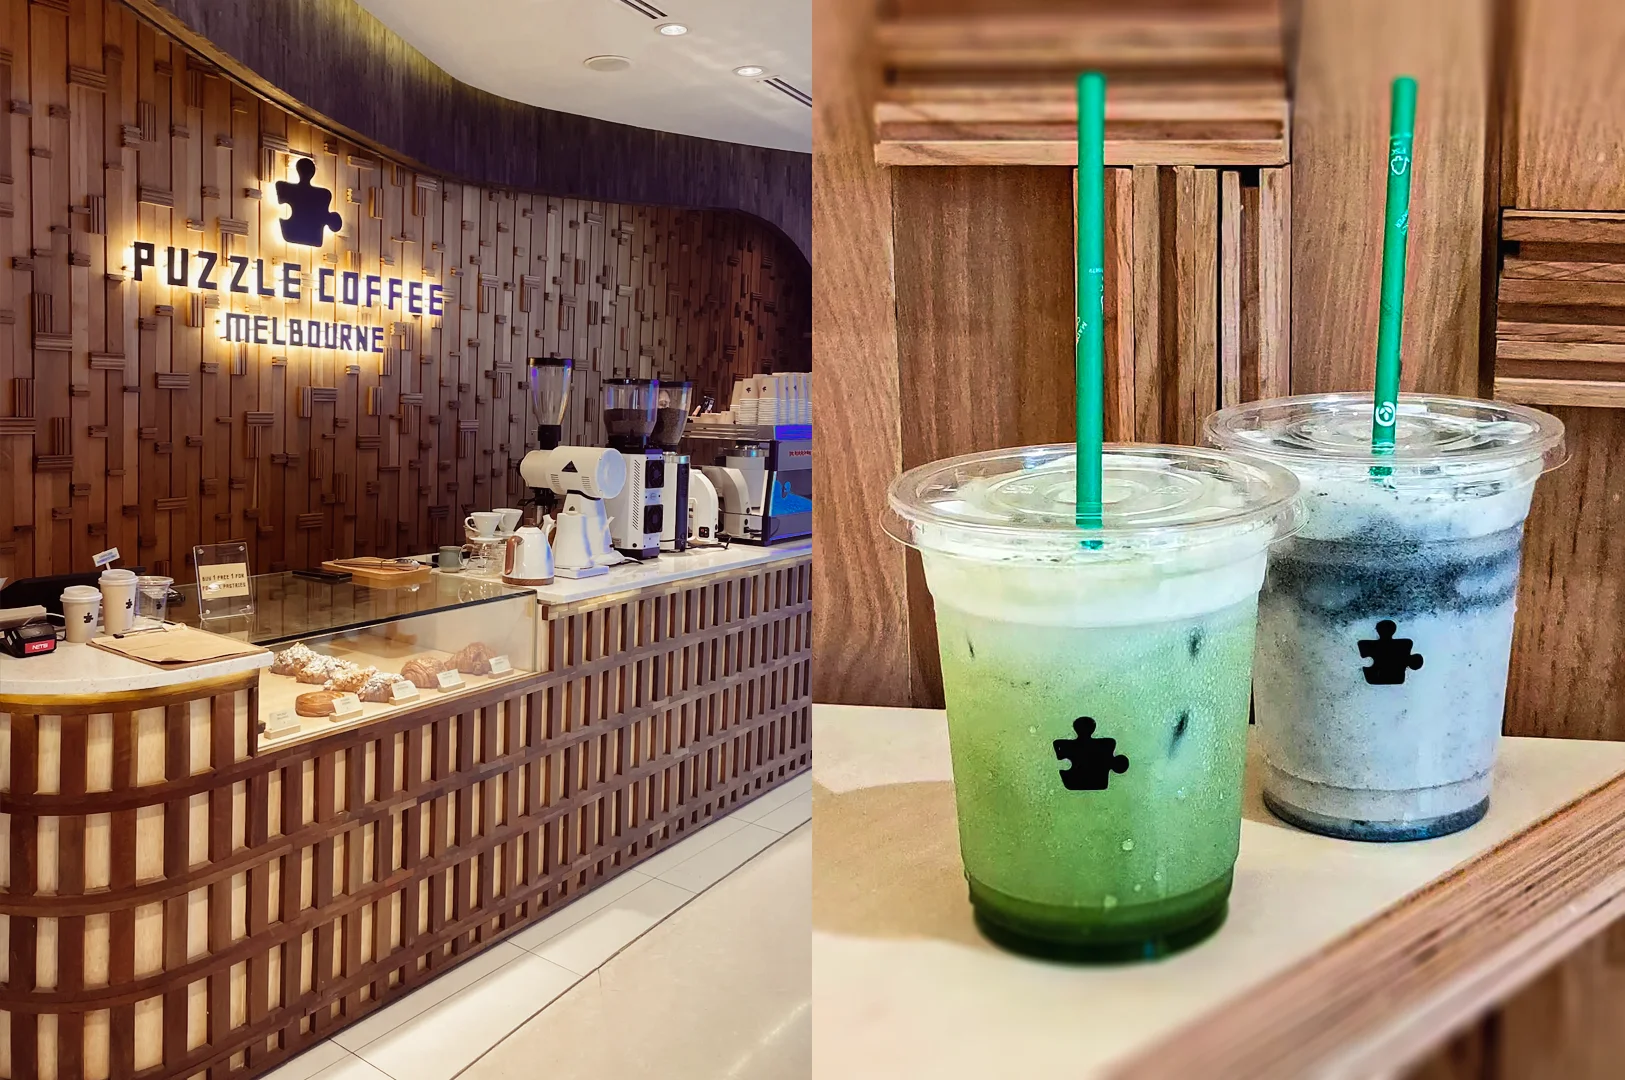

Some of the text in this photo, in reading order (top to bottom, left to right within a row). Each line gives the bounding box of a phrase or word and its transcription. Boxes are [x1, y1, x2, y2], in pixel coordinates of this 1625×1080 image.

[133, 241, 443, 316] PUZZLE COFFEE
[225, 312, 384, 353] MELBOURNE
